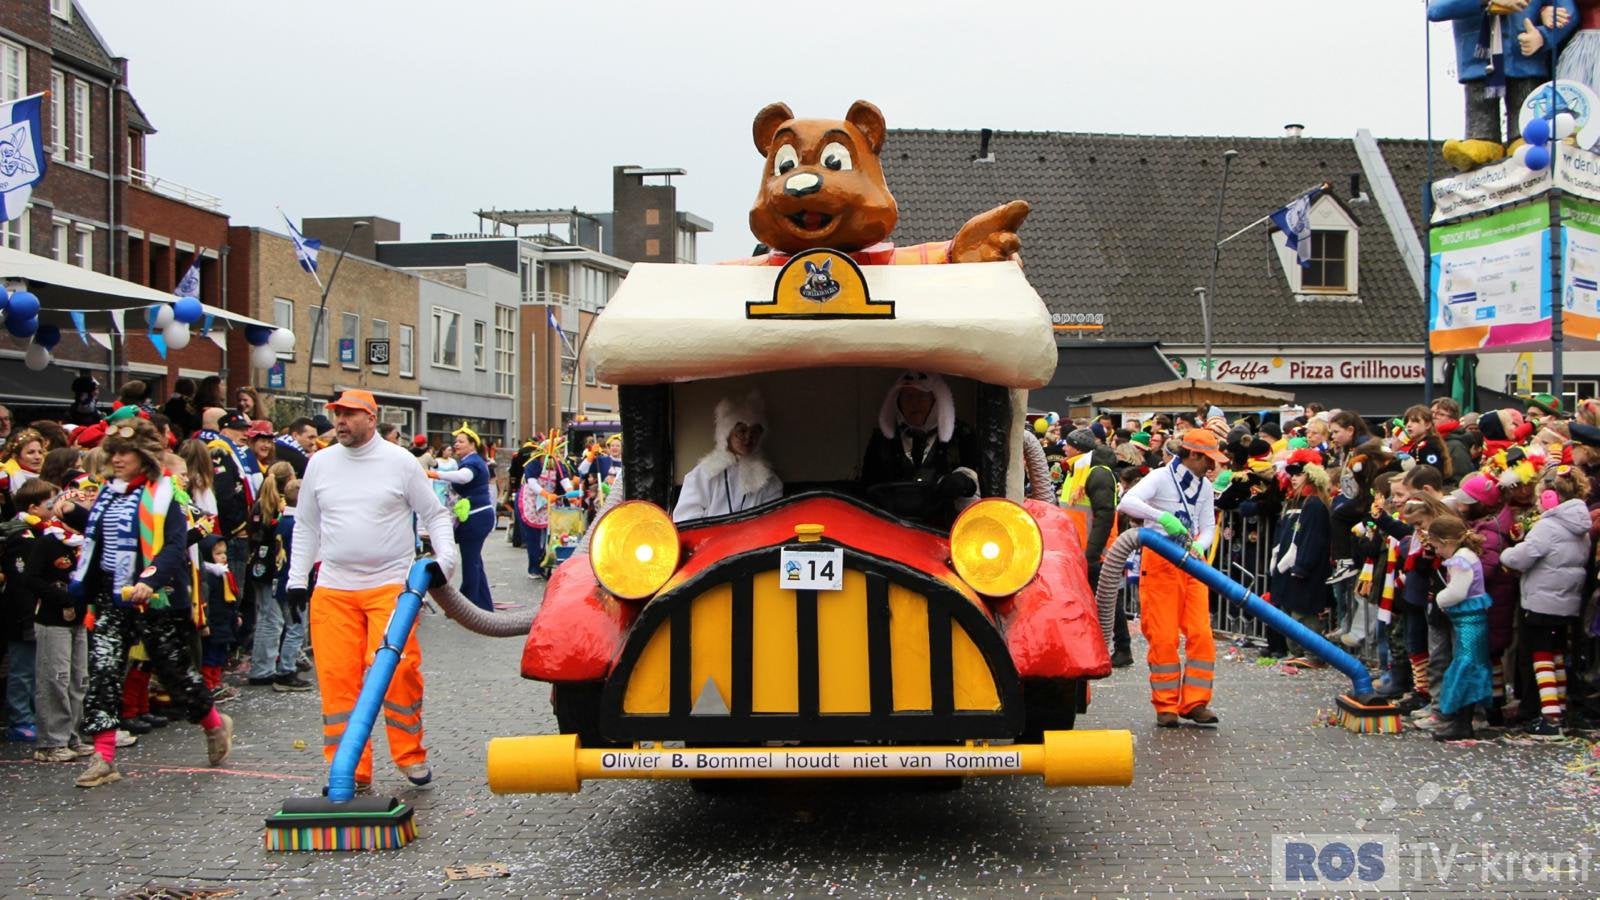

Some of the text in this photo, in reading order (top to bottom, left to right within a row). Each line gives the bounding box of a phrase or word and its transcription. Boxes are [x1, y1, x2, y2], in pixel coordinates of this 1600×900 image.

[1052, 313, 1104, 324] sprong
[1216, 360, 1269, 380] Jaffa
[1290, 361, 1333, 379] Pizza
[808, 560, 835, 581] 14
[602, 751, 1020, 769] Olivier B. Bommel houdt niet van Rommel
